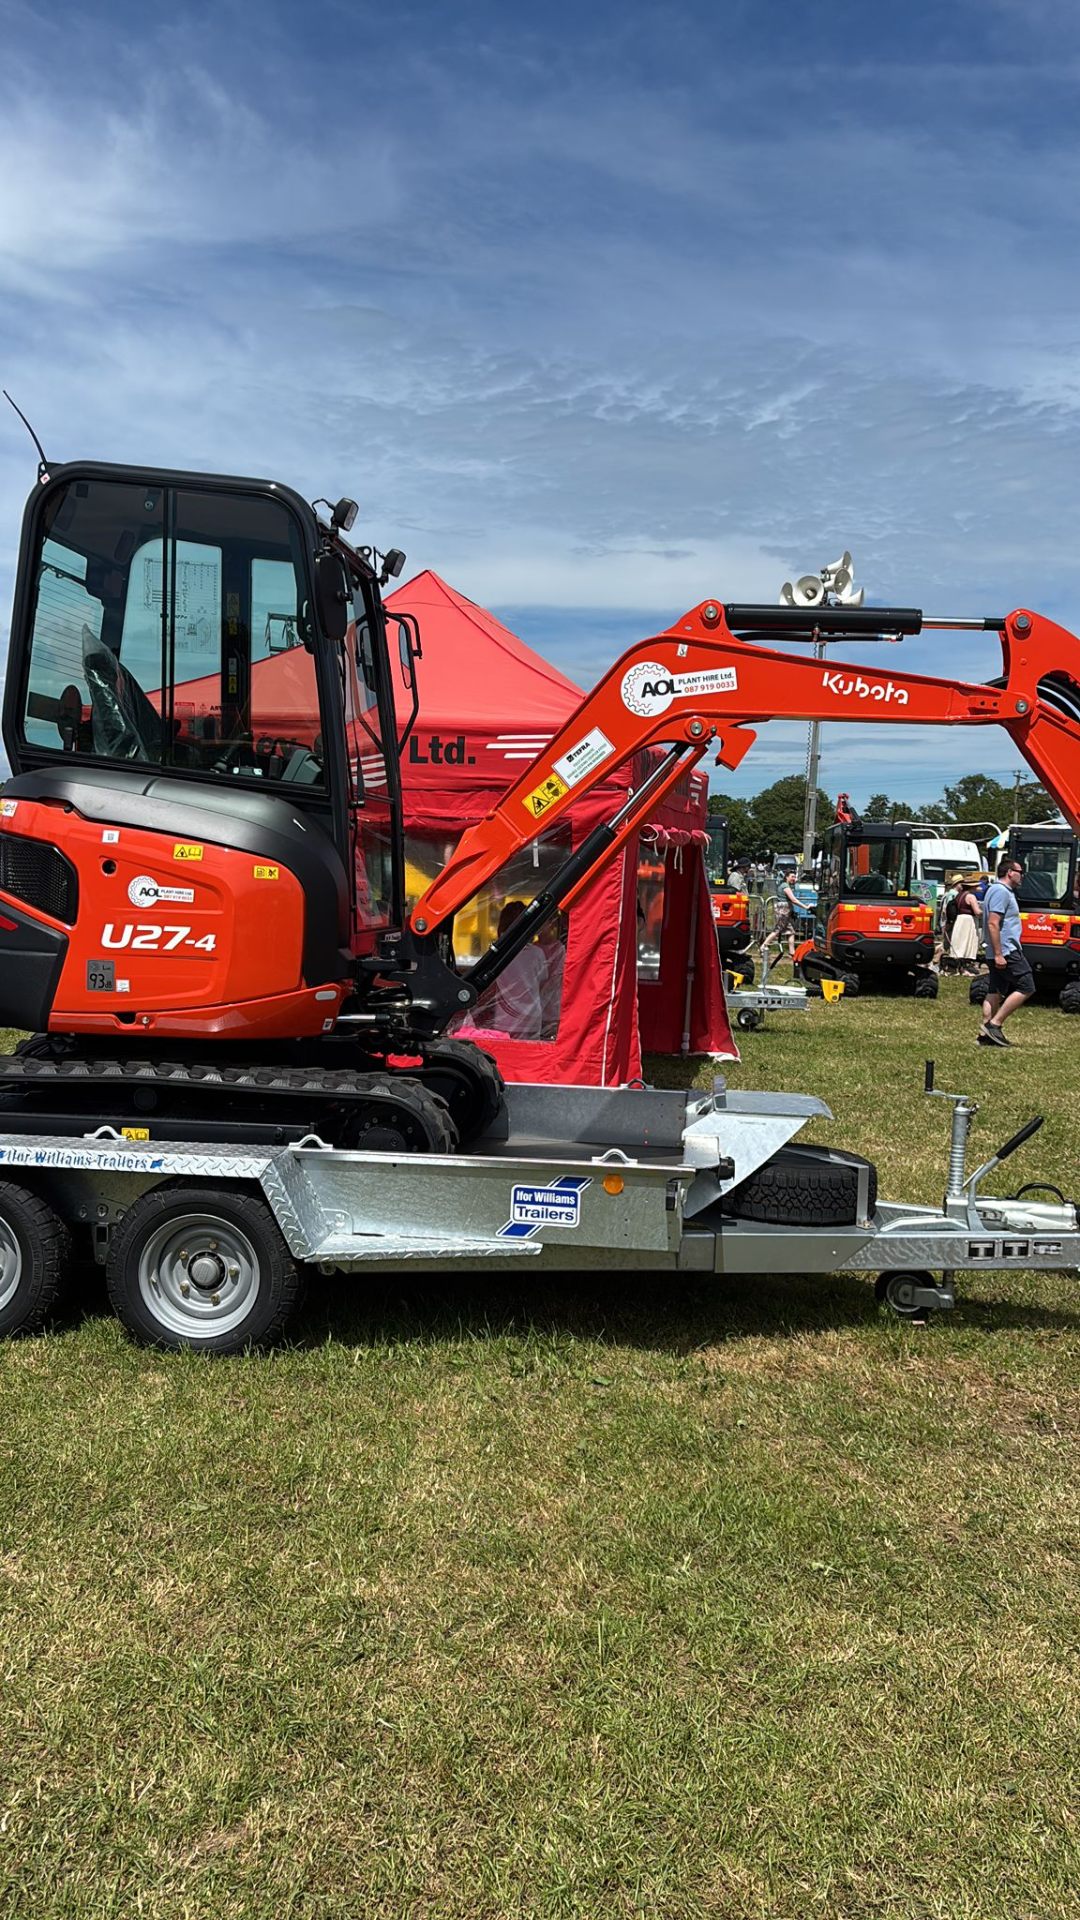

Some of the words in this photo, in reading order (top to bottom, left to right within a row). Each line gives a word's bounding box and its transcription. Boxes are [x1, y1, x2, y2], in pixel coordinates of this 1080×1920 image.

[678, 676, 701, 685] PLANT
[702, 674, 719, 682] HIRE
[720, 672, 734, 680] Ltd.
[641, 678, 682, 698] AOL
[684, 685, 699, 693] 087
[700, 683, 715, 691] 919
[716, 681, 735, 689] 0033
[822, 671, 909, 705] Kubota
[409, 735, 476, 765] Ltd.
[572, 742, 590, 758] TEFRA
[139, 887, 162, 898] AOL
[101, 923, 216, 951] U27-4
[516, 1190, 533, 1202] Ifor
[534, 1191, 575, 1205] Williams
[516, 1205, 575, 1221] Trailers
